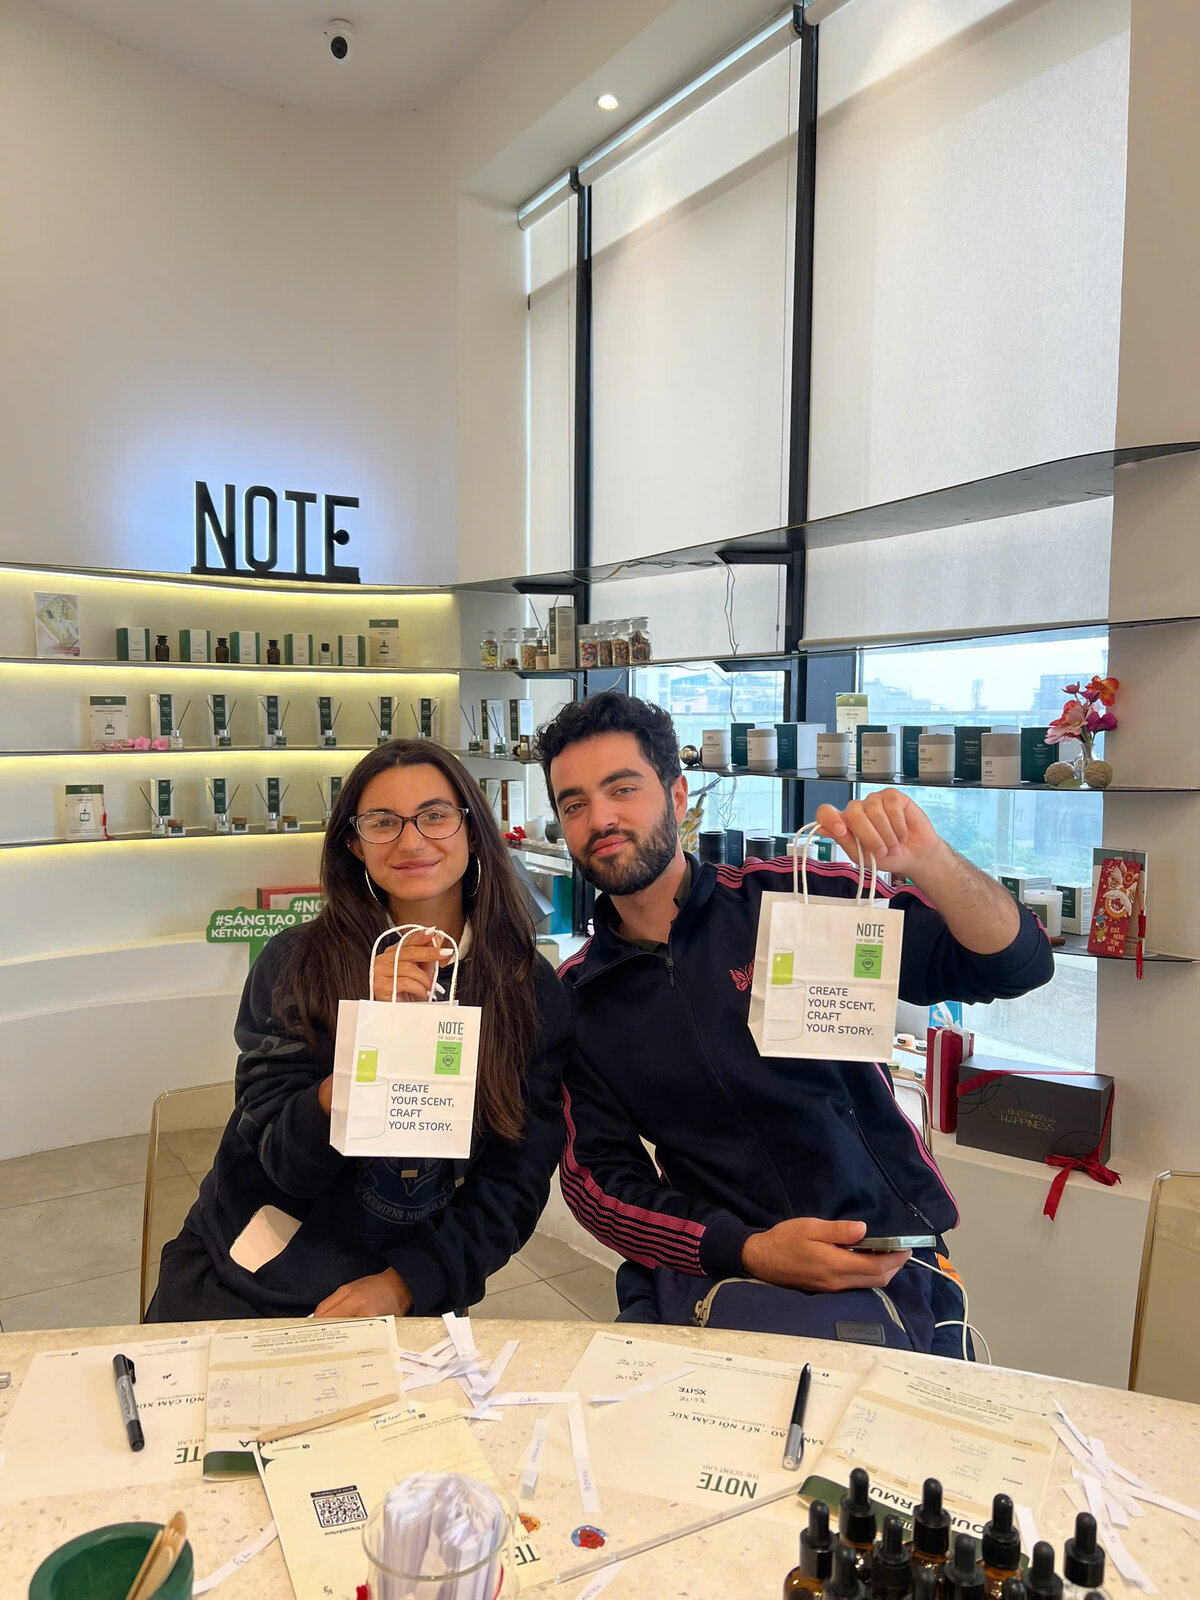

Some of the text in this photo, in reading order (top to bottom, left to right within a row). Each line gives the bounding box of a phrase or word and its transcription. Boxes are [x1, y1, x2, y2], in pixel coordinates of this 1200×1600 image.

[195, 480, 361, 579] NOTE
[215, 911, 266, 927] #SÁNG
[856, 922, 885, 938] NOTE
[809, 986, 849, 997] CREATE
[808, 998, 876, 1012] YOUR SCENT,
[807, 1011, 842, 1021] CRAFT
[437, 1021, 464, 1035] NOTE
[806, 1023, 874, 1036] YOUR STORY.
[391, 1083, 429, 1093] CREATE
[390, 1096, 454, 1107] YOUR SCENT,
[389, 1108, 422, 1118] CRAFT
[389, 1120, 453, 1132] YOUR STORY.
[1000, 1113, 1055, 1132] HAPPINESS
[678, 1386, 708, 1396] XSITE
[174, 1446, 202, 1465] TE
[695, 1472, 758, 1499] NOTE
[514, 1544, 541, 1567] TE
